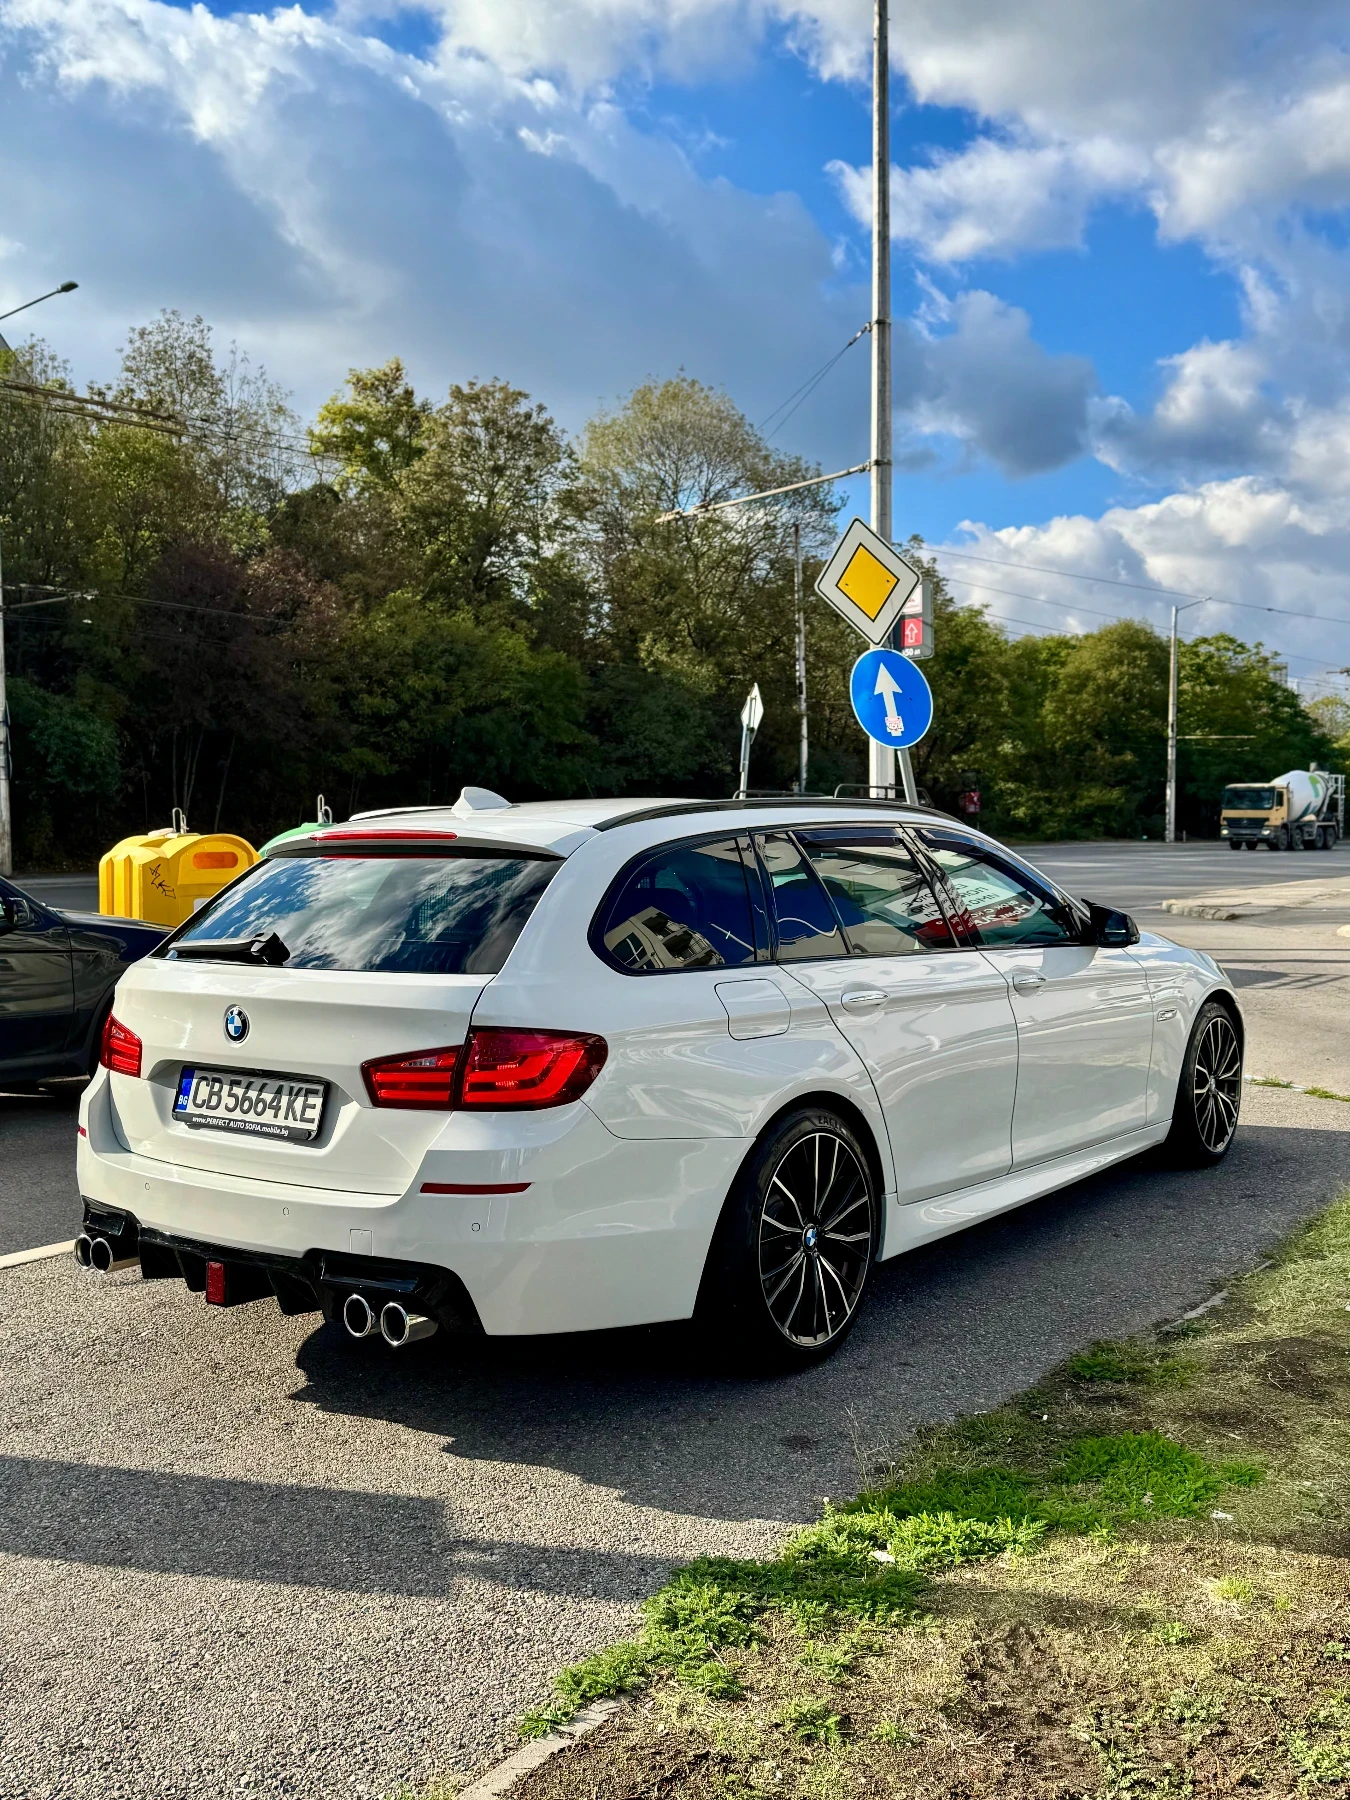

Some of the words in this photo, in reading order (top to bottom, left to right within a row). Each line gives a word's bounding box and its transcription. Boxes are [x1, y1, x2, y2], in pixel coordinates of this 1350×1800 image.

[177, 1094, 188, 1106] BG
[192, 1116, 229, 1127] www.PERFECT
[229, 1121, 245, 1129] AUTO
[245, 1123, 289, 1137] SOFIA.mobile.bg
